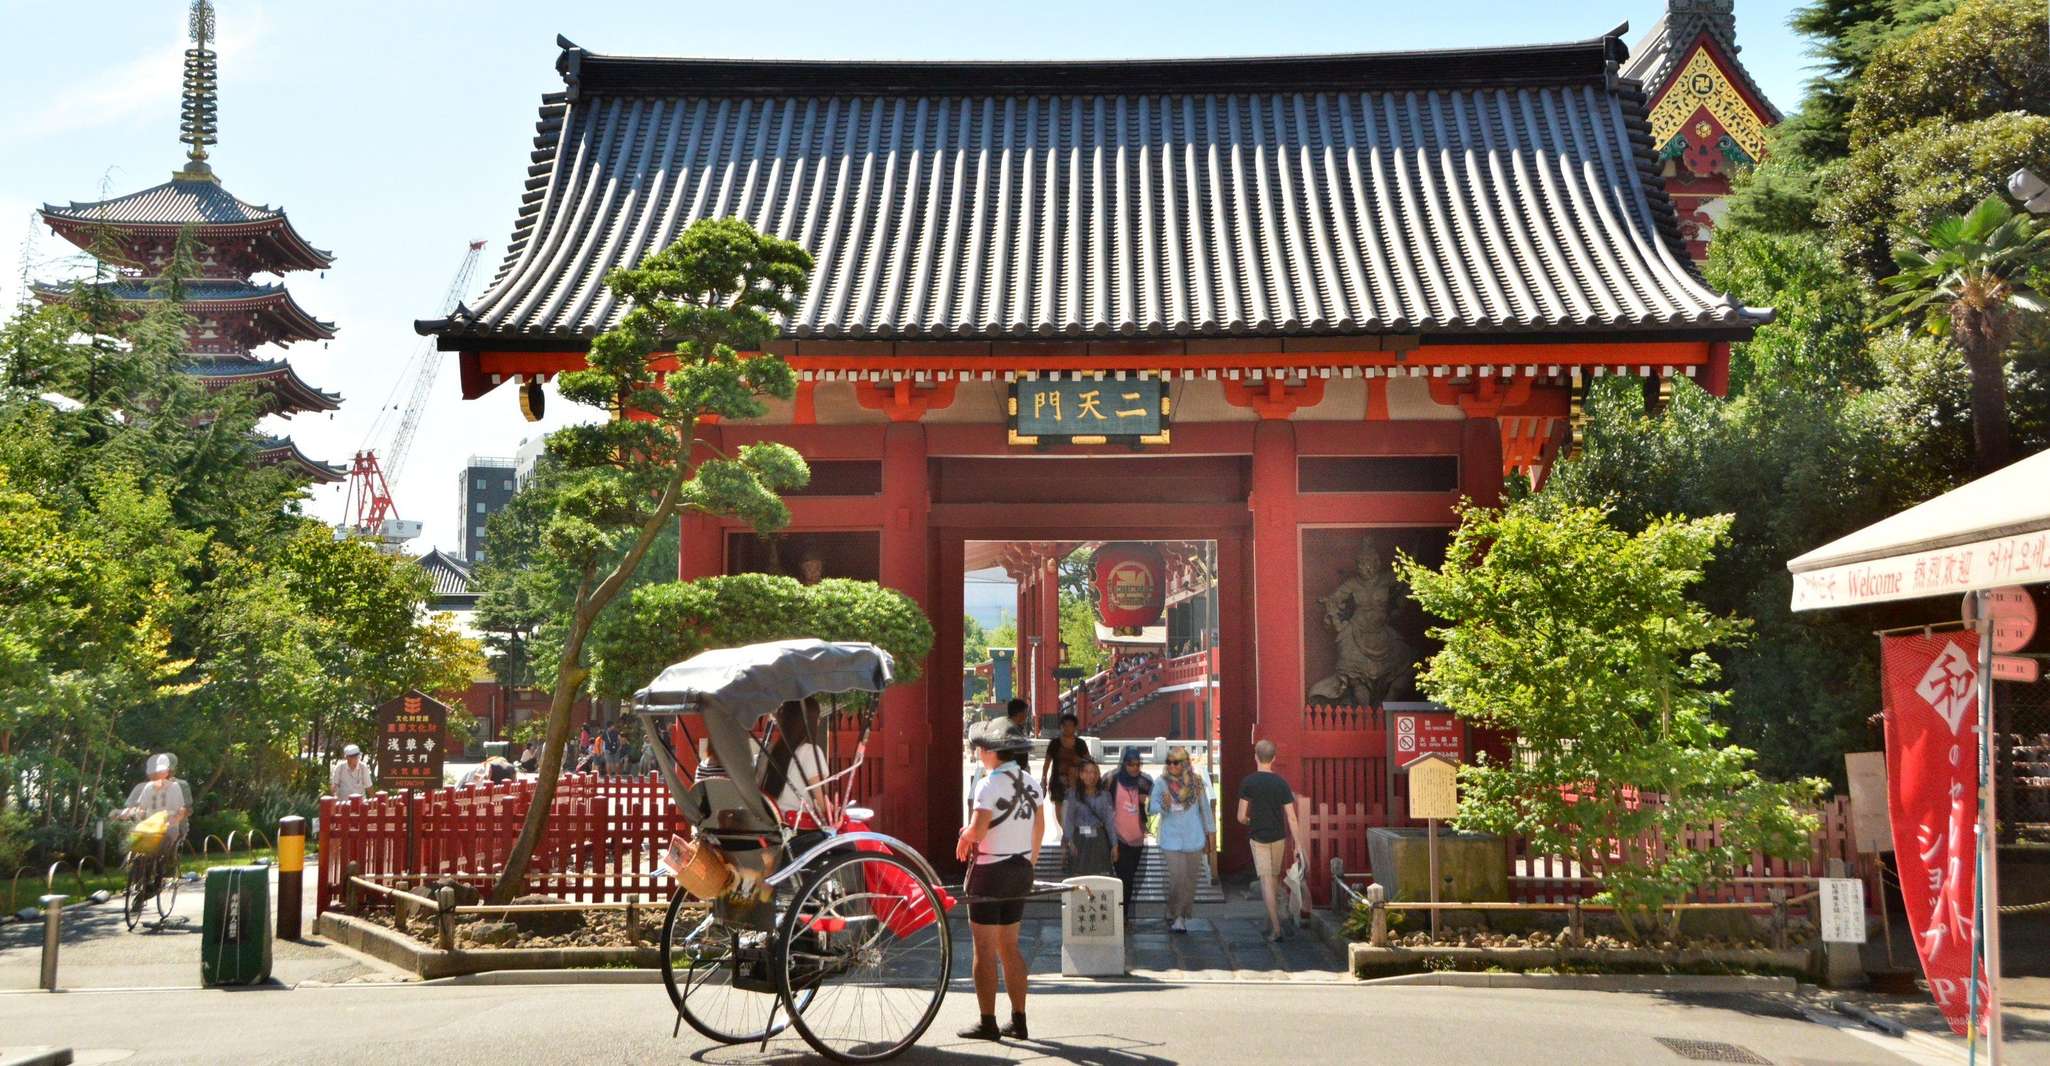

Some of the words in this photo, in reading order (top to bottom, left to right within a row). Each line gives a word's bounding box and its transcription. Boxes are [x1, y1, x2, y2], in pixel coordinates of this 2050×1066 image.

[1848, 566, 1902, 597] Welcome
[393, 754, 428, 763] 二天門
